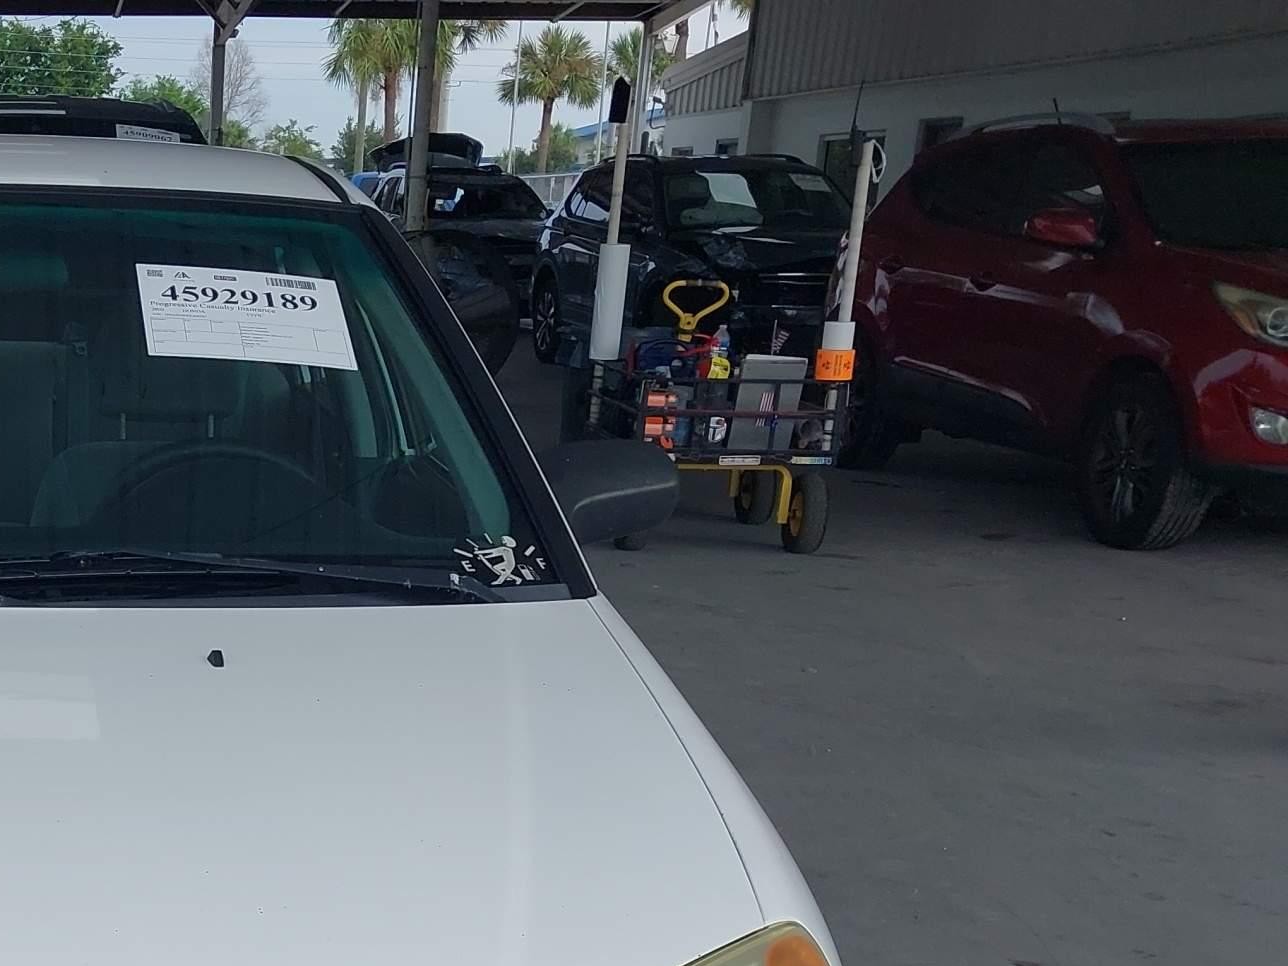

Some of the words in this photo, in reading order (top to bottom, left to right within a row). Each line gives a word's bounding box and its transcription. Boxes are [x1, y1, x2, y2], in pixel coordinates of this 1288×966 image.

[161, 284, 318, 311] 45929189
[150, 300, 198, 309] Progressive
[199, 303, 236, 311] Casualty
[237, 305, 277, 314] Insurance
[461, 560, 476, 572] E
